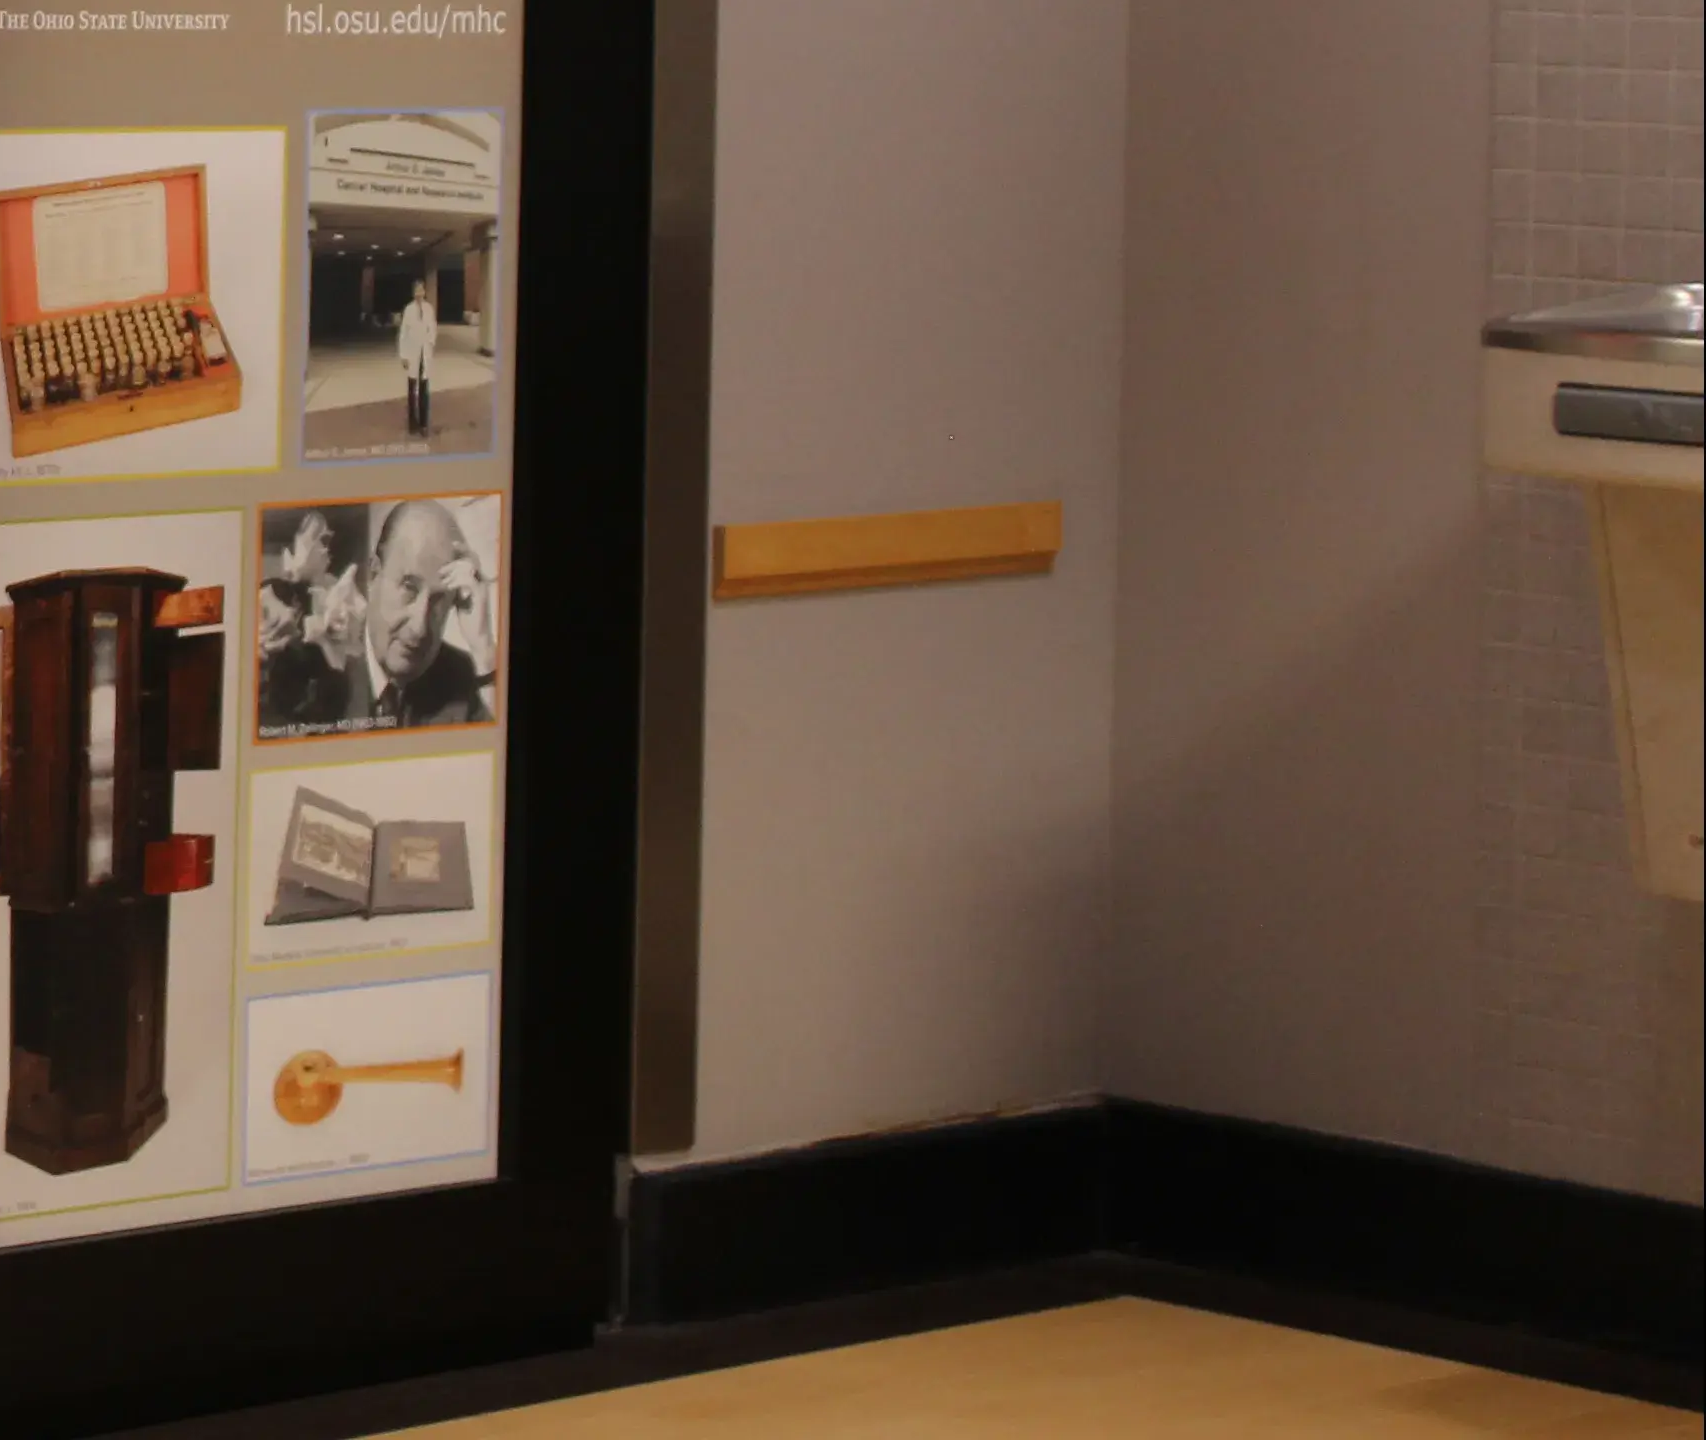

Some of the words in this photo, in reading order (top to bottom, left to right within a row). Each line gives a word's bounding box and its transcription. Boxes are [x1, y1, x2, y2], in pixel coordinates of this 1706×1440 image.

[286, 3, 508, 40] hsl.osu.edu/mhc
[370, 182, 403, 195] Hospital
[405, 185, 421, 196] and
[258, 724, 286, 738] Robert
